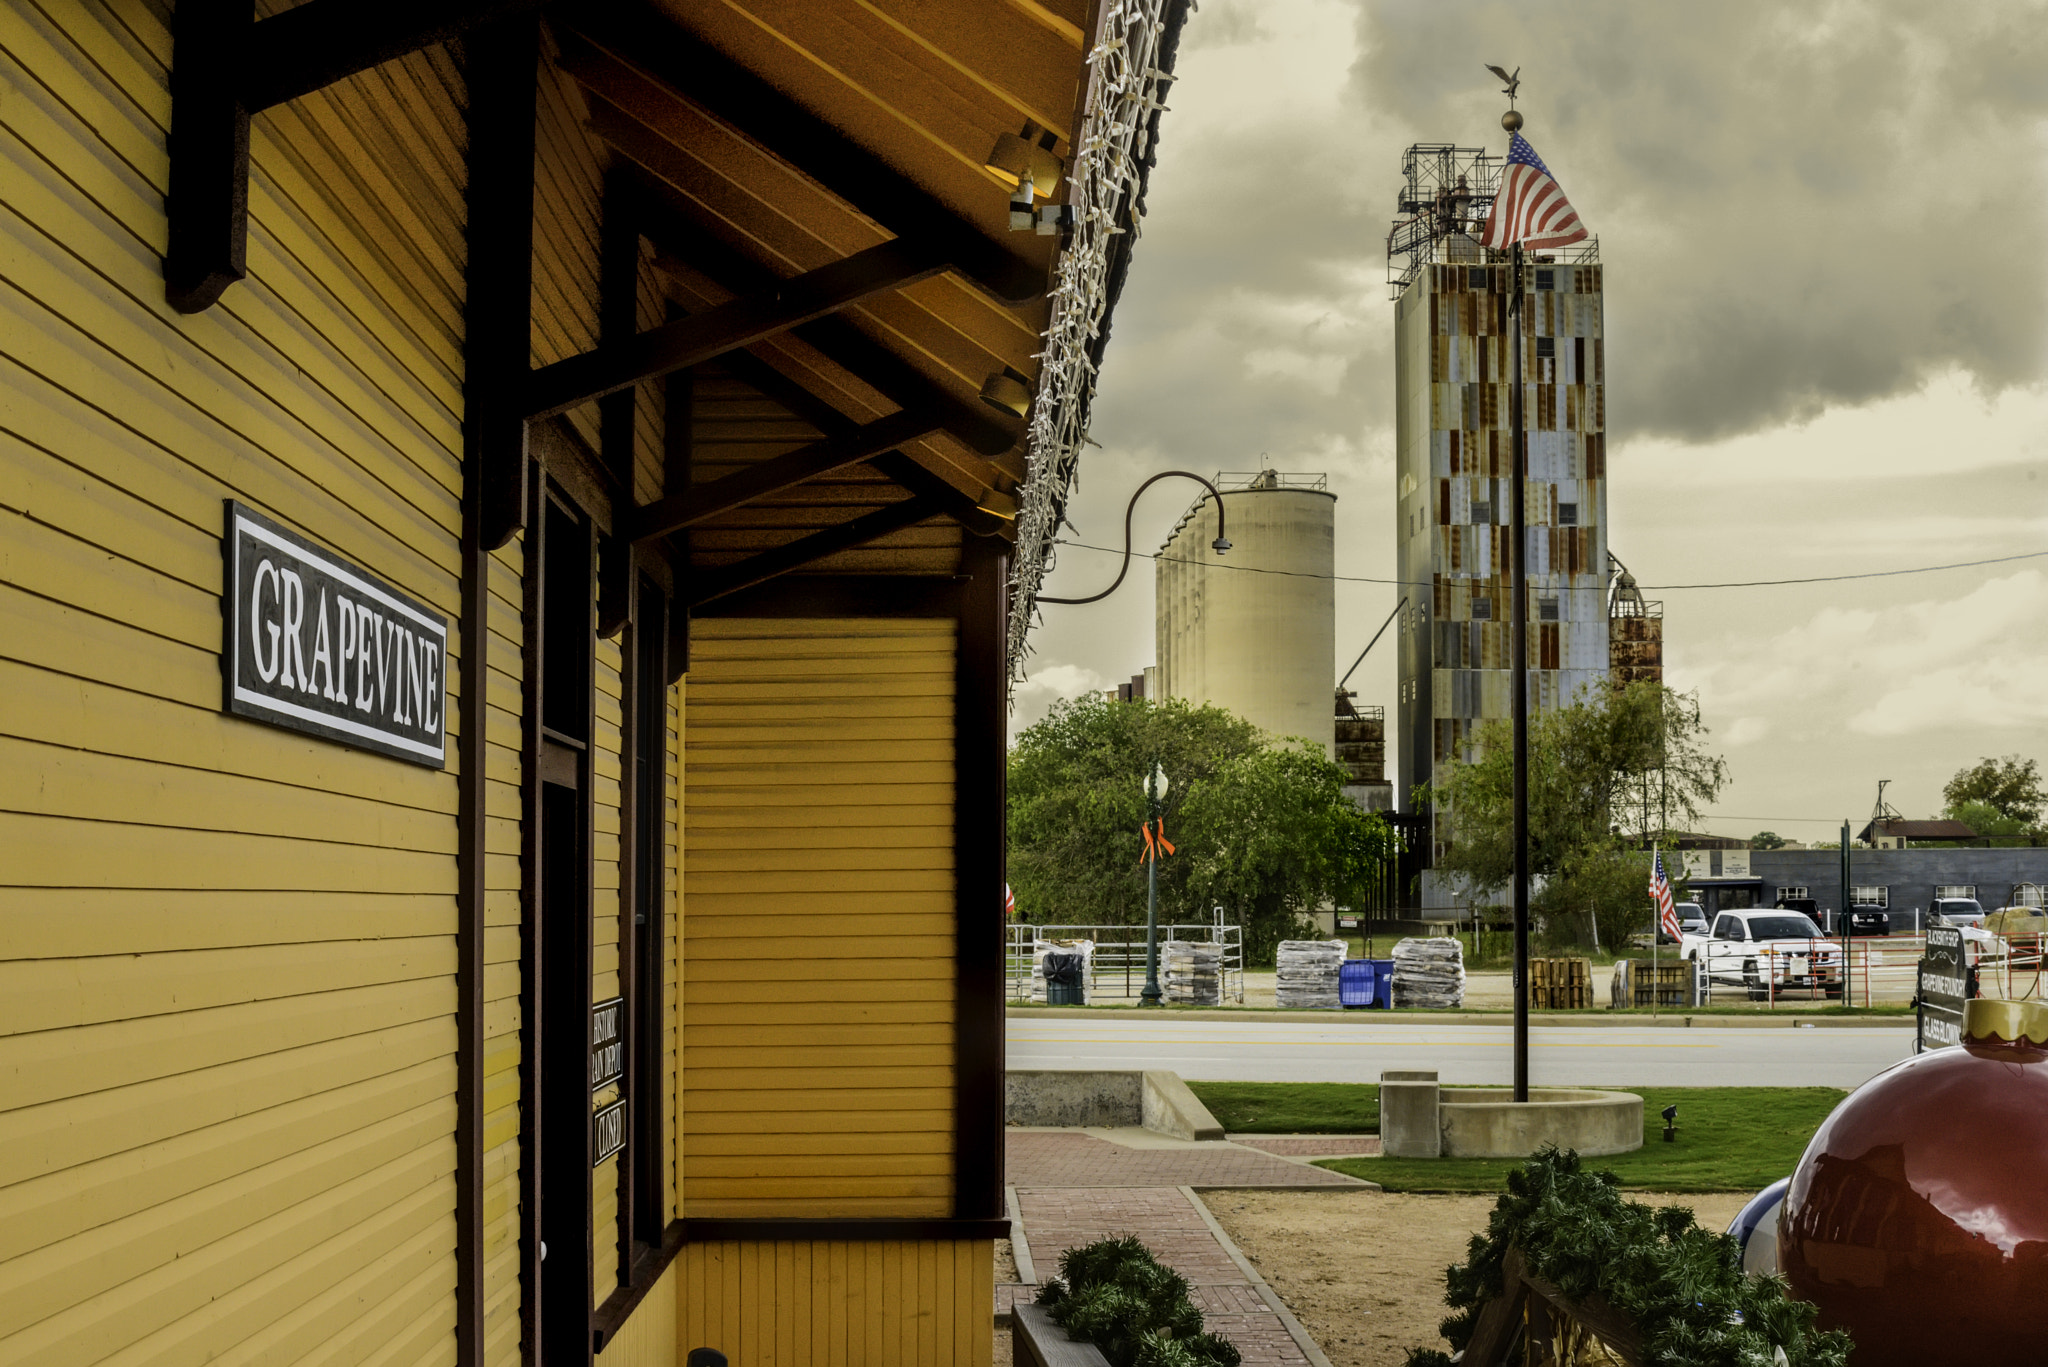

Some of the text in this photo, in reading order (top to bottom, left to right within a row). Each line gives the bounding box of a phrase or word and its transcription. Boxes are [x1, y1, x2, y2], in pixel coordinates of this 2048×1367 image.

[252, 559, 438, 734] GRAPEVINE
[1927, 929, 1959, 947] BLACKSMITH SHOP
[1922, 972, 1966, 998] GRAPEVINE FOUNDRY
[593, 1007, 617, 1044] HISTORIC
[1924, 1016, 1940, 1041] GLASS
[604, 1042, 621, 1077] DEPOT
[599, 1107, 621, 1158] CLOSED
